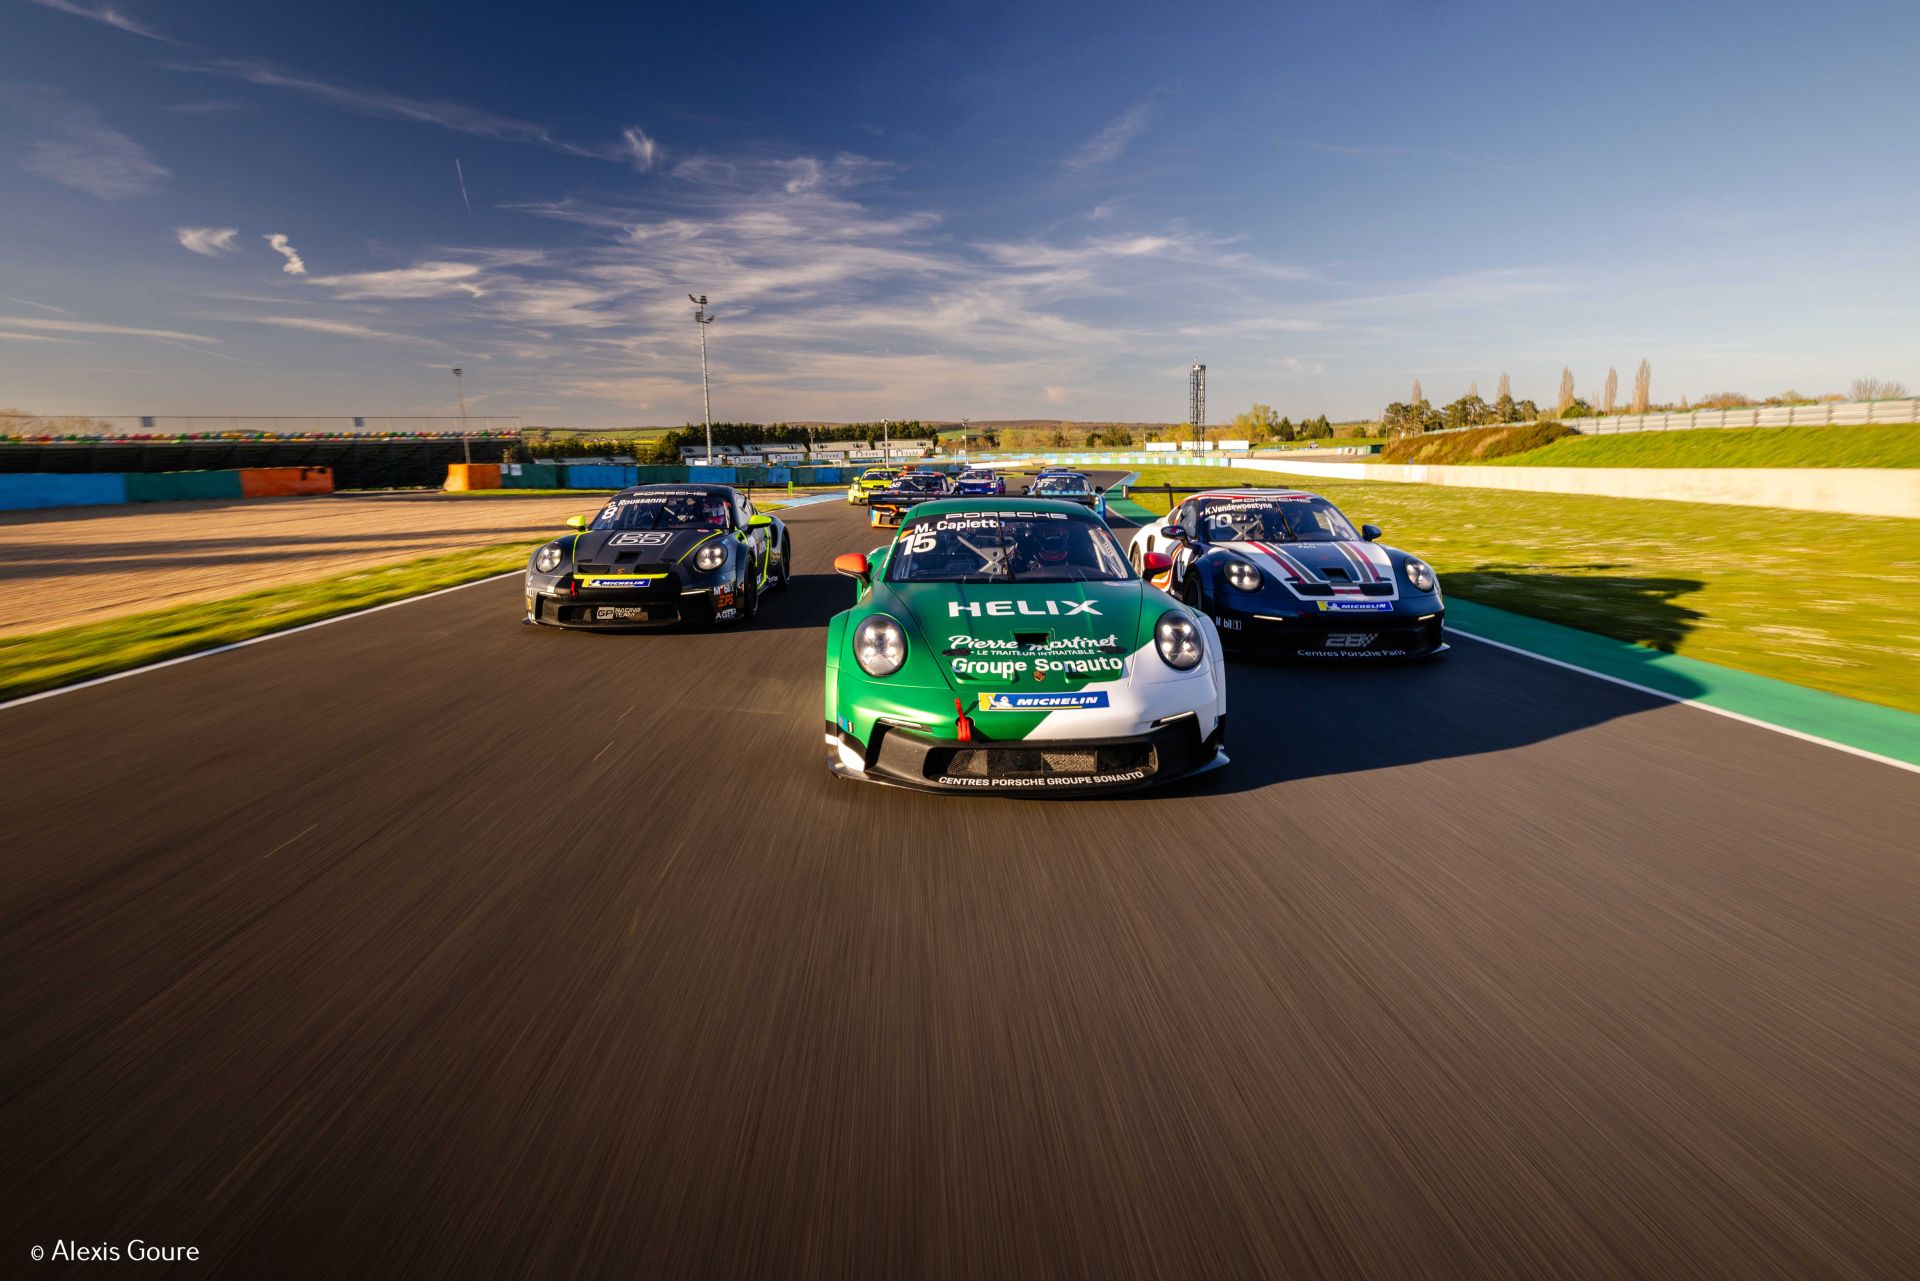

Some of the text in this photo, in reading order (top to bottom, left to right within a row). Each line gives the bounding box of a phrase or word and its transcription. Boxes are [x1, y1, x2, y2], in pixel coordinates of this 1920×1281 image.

[601, 507, 618, 520] 8
[945, 512, 1068, 520] PORSCHE
[1204, 513, 1232, 530] 10
[914, 523, 932, 535] M.
[899, 531, 937, 556] 15
[948, 599, 1104, 618] HELIX
[1216, 616, 1232, 629] Mbil
[948, 635, 1018, 649] Pierre
[1297, 649, 1338, 657] Centres
[951, 656, 1123, 679] Groupe Sonauto
[1016, 696, 1098, 706] MICHELIN
[938, 771, 1145, 786] CENTRES PORSCHE GROUPE SONAUTO
